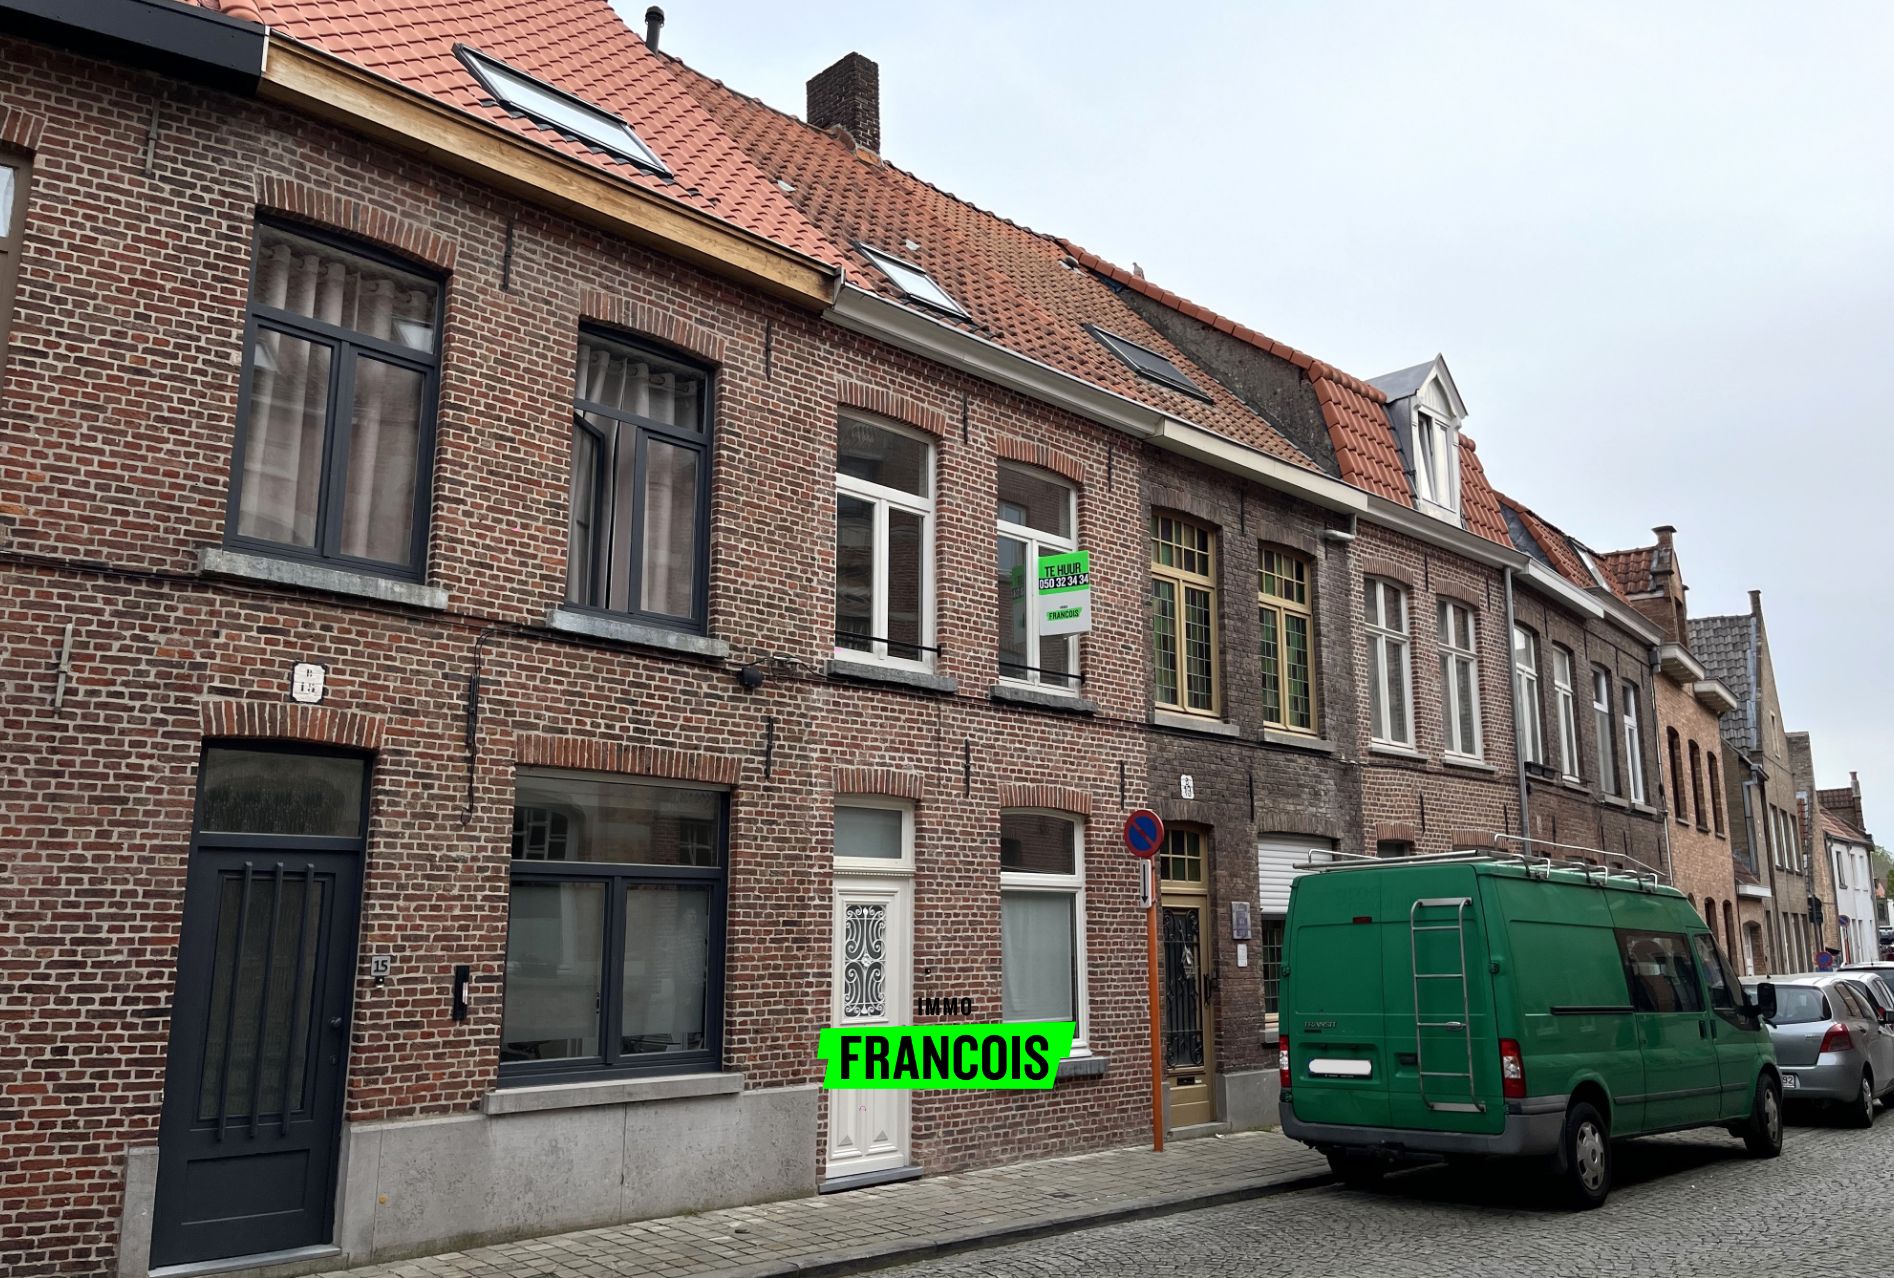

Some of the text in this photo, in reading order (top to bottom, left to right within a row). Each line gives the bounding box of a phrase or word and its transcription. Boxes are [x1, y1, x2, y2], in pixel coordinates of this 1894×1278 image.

[1045, 562, 1082, 578] TE HUUR
[1040, 574, 1089, 589] 050 32 34 34
[1048, 609, 1080, 621] FRANCOIS
[373, 959, 388, 973] 15
